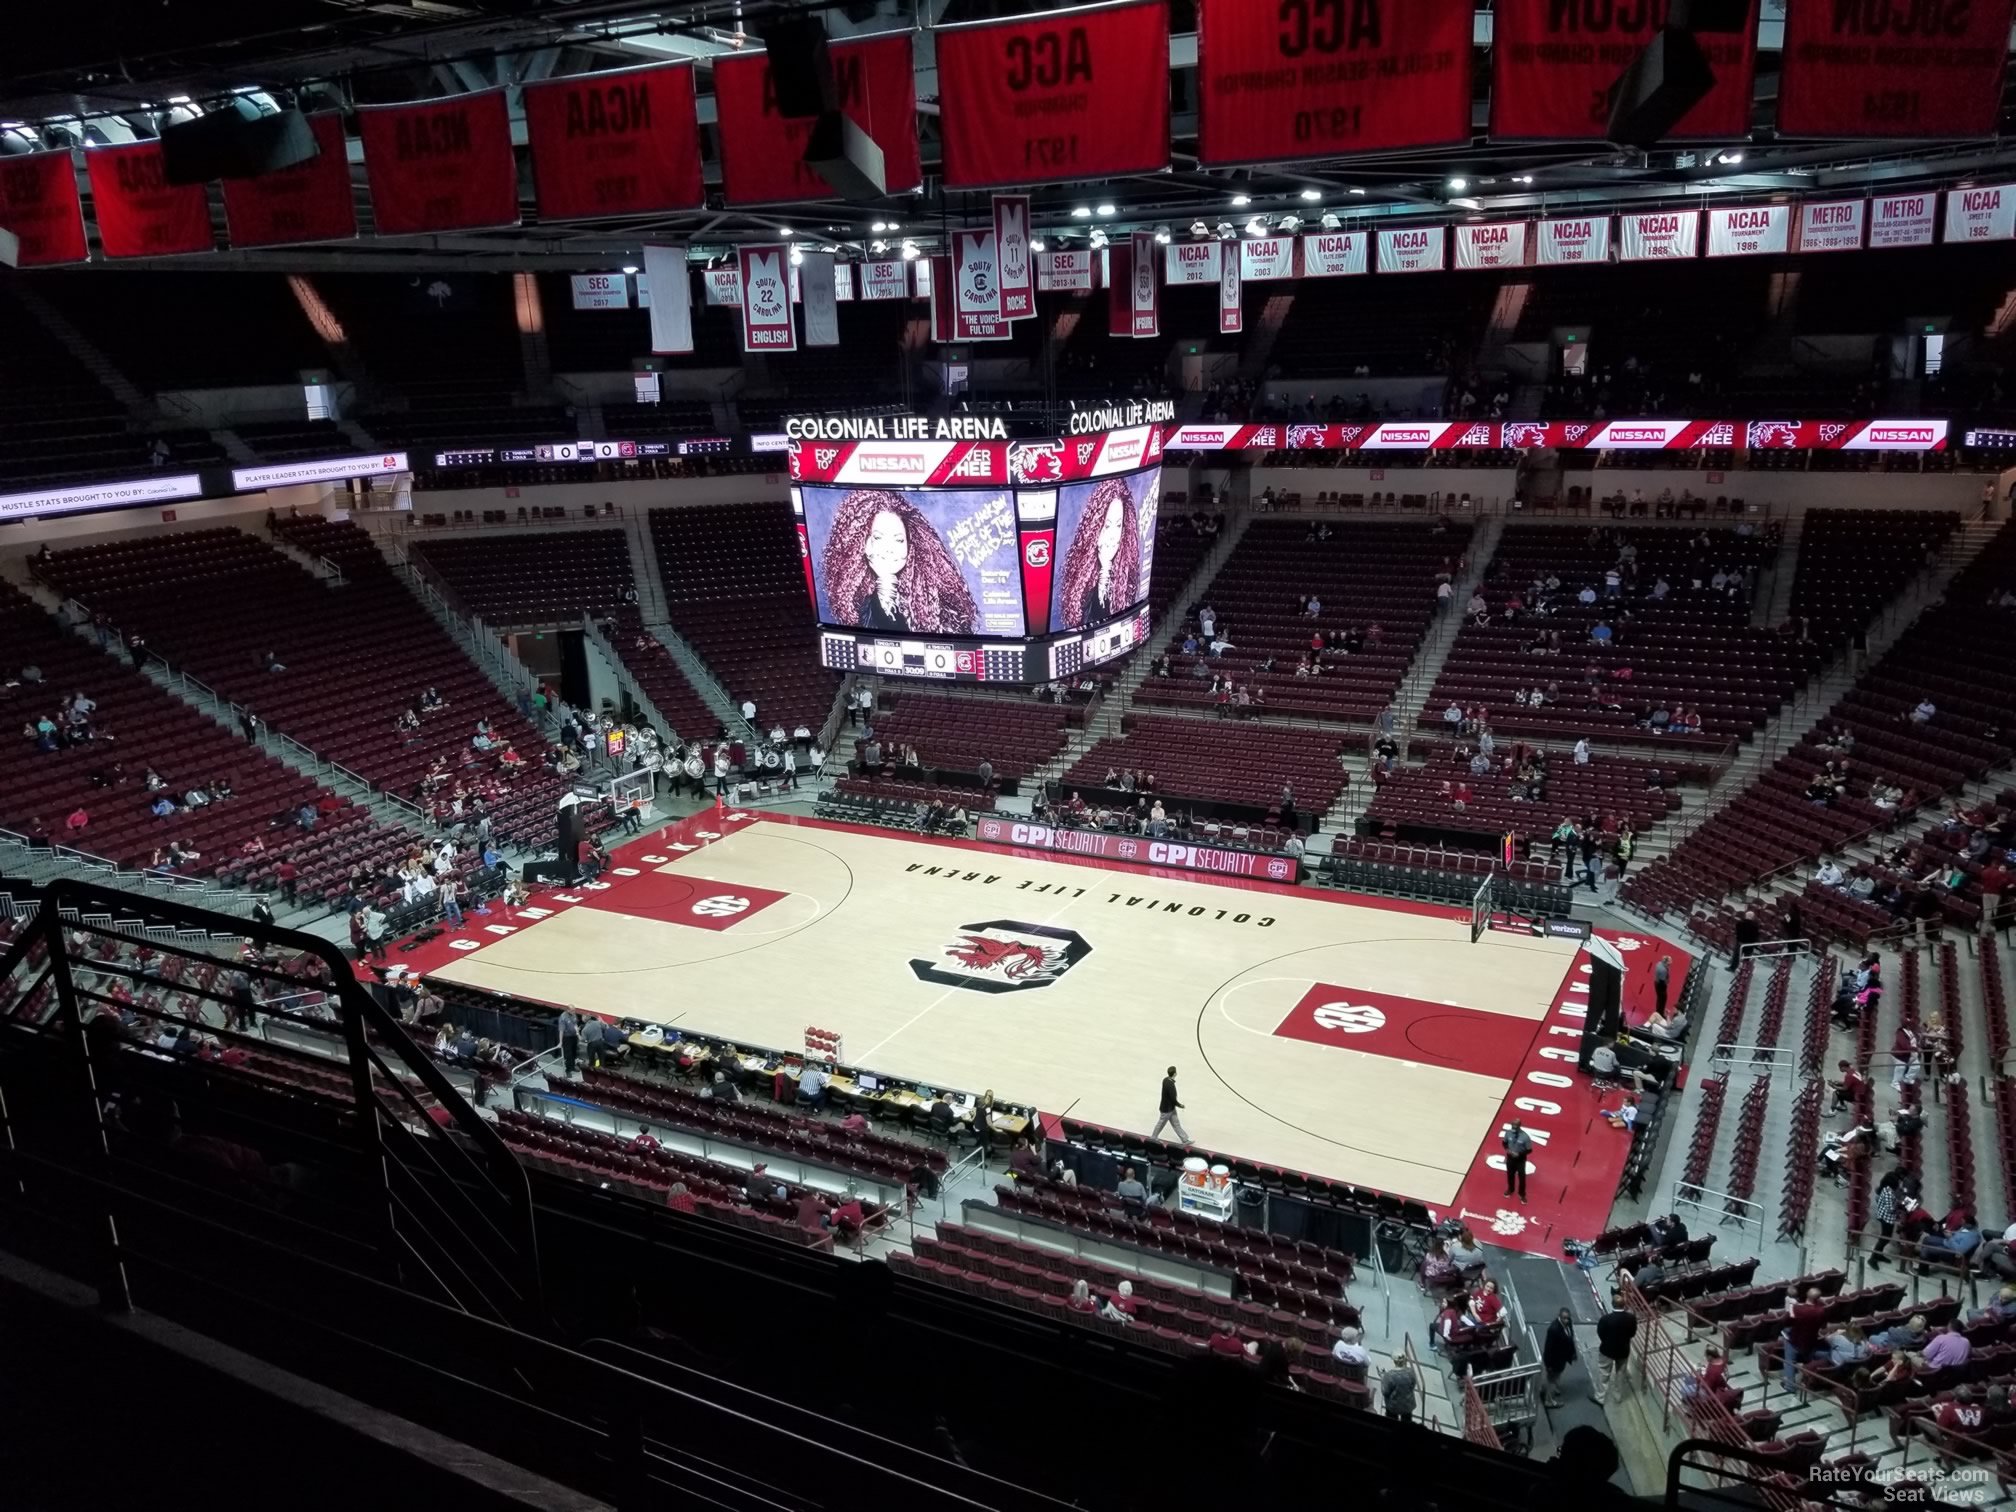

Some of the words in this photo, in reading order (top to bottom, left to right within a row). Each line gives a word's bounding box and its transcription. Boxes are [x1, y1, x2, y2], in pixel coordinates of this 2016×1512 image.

[1963, 190, 2001, 211] NCAA
[1812, 205, 1852, 225] METRO
[1883, 198, 1924, 219] METRO
[1639, 216, 1679, 234] NCAA
[1728, 211, 1770, 229] NCAA
[1472, 227, 1508, 245] NCAA
[1554, 222, 1591, 240] NCAA
[1969, 226, 1989, 237] 1982
[1319, 237, 1352, 253] NCAA
[1393, 231, 1428, 249] NCAA
[1737, 241, 1758, 251] 1986
[1010, 247, 1019, 263] 11
[1179, 246, 1210, 261] NCAA
[1247, 242, 1279, 257] NCAA
[968, 262, 992, 273] SOUTH
[1054, 255, 1075, 269] SEC
[1401, 260, 1419, 268] 1991
[1480, 256, 1499, 265] 1990
[875, 264, 893, 278] SEC
[1254, 268, 1271, 277] 2003
[1326, 264, 1344, 272] 2002
[714, 274, 738, 286] NCAA
[1187, 272, 1203, 280] 2012
[589, 277, 609, 290] SEC
[755, 278, 776, 289] SOUTH
[1052, 279, 1077, 288] 2013-14
[761, 290, 773, 302] 22
[964, 289, 998, 304] CAROLINA
[1006, 295, 1027, 311] ROCHE
[752, 303, 783, 317] CAROLINA
[752, 330, 788, 344] ENGLISH
[969, 325, 996, 335] FULTON
[1070, 407, 1124, 434] COLONIAL
[1126, 404, 1143, 426] LIFE
[1144, 401, 1175, 423] ARENA
[786, 418, 888, 439] COLONIAL
[893, 418, 929, 439] LIFE
[934, 418, 1008, 439] ARENA
[1381, 431, 1429, 440] NISSAN
[1610, 431, 1665, 440] NISSAN
[1870, 430, 1933, 441] NISSAN
[1181, 433, 1223, 442] NISSAN
[562, 447, 570, 457] 0
[602, 445, 611, 456] 0
[860, 456, 923, 471] NISSAN
[246, 473, 271, 482] PLAYER
[272, 470, 297, 480] LEADER
[298, 468, 318, 477] STATS
[319, 465, 347, 475] BROUGHT
[358, 463, 370, 471] YOU
[2, 500, 33, 511] HUSTLE
[35, 497, 62, 508] STATS
[62, 493, 100, 504] BROUGHT
[115, 490, 131, 498] YOU
[132, 488, 145, 497] BY:
[1099, 639, 1106, 653] 0
[884, 650, 894, 665] 0
[935, 654, 946, 668] 0
[904, 666, 925, 676] 30:09
[984, 825, 999, 835] CPI
[1011, 823, 1056, 846] CPI
[1055, 830, 1108, 855] SECURITY
[1121, 843, 1136, 854] CPI
[1148, 842, 1197, 868] CPI
[1197, 849, 1257, 875] SECURITY
[905, 862, 1002, 884] ARENA
[1269, 863, 1287, 873] CPI
[1016, 880, 1086, 897] LIFE
[1107, 893, 1277, 928] COLONIAL
[1549, 923, 1581, 934] verizon
